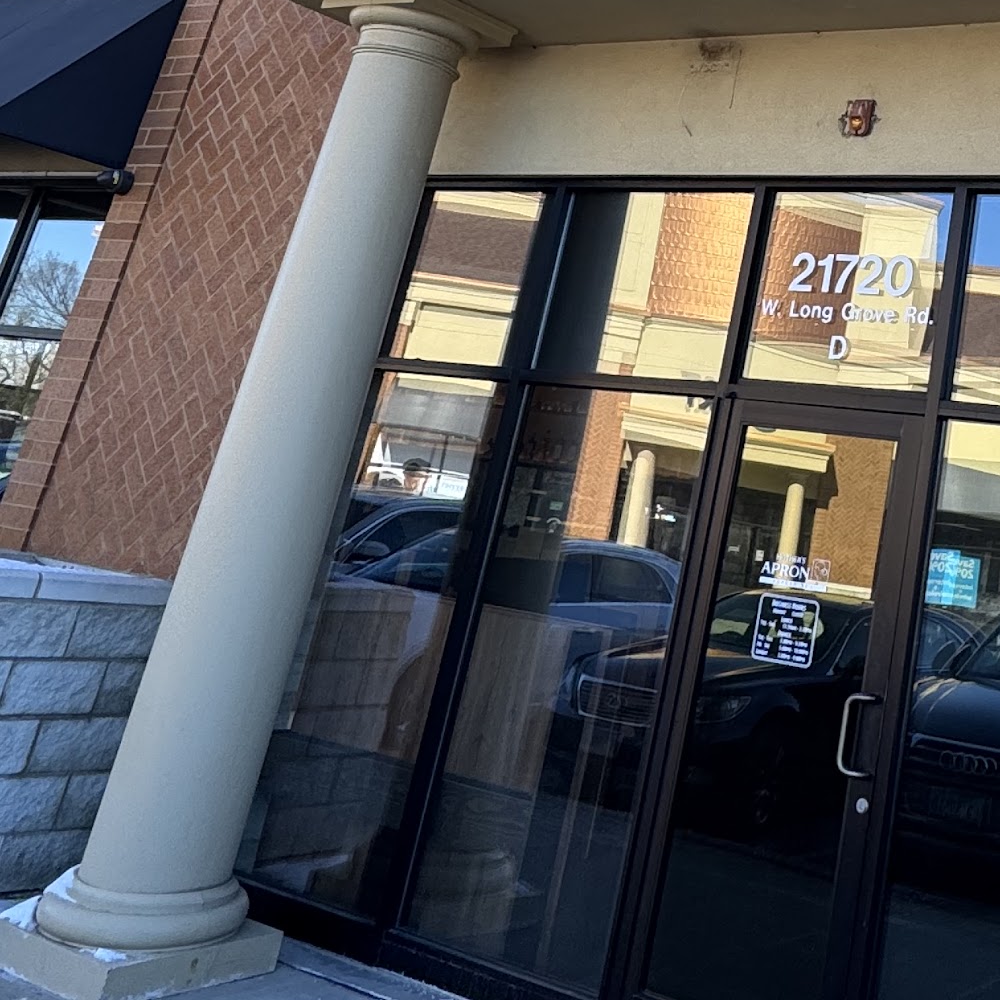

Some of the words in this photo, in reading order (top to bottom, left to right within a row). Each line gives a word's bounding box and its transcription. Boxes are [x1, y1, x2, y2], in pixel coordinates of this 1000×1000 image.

[788, 252, 914, 297] 21720
[761, 299, 781, 317] W.
[789, 303, 833, 324] Long
[841, 303, 896, 323] Grove
[904, 306, 935, 325] Rd.
[828, 335, 848, 360] D
[760, 561, 810, 581] APRON
